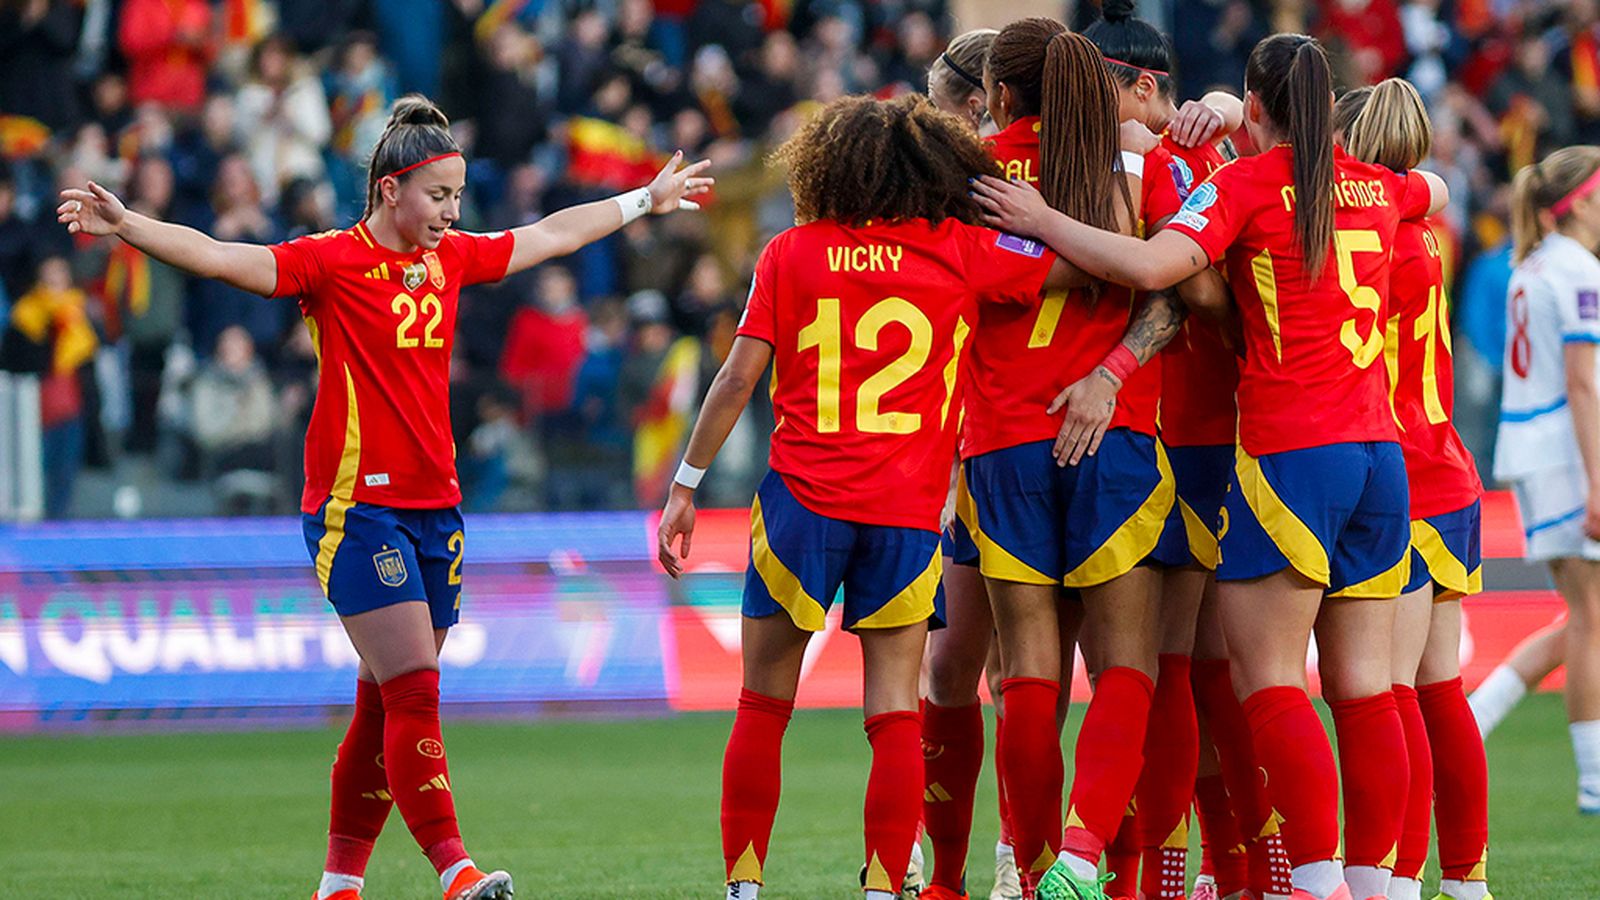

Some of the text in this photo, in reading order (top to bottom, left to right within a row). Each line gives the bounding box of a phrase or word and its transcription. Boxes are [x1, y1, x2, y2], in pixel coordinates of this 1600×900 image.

[391, 292, 444, 349] 22
[827, 244, 902, 272] VICKY
[1333, 230, 1384, 369] 5
[797, 296, 933, 434] 12
[1414, 284, 1452, 425] 1
